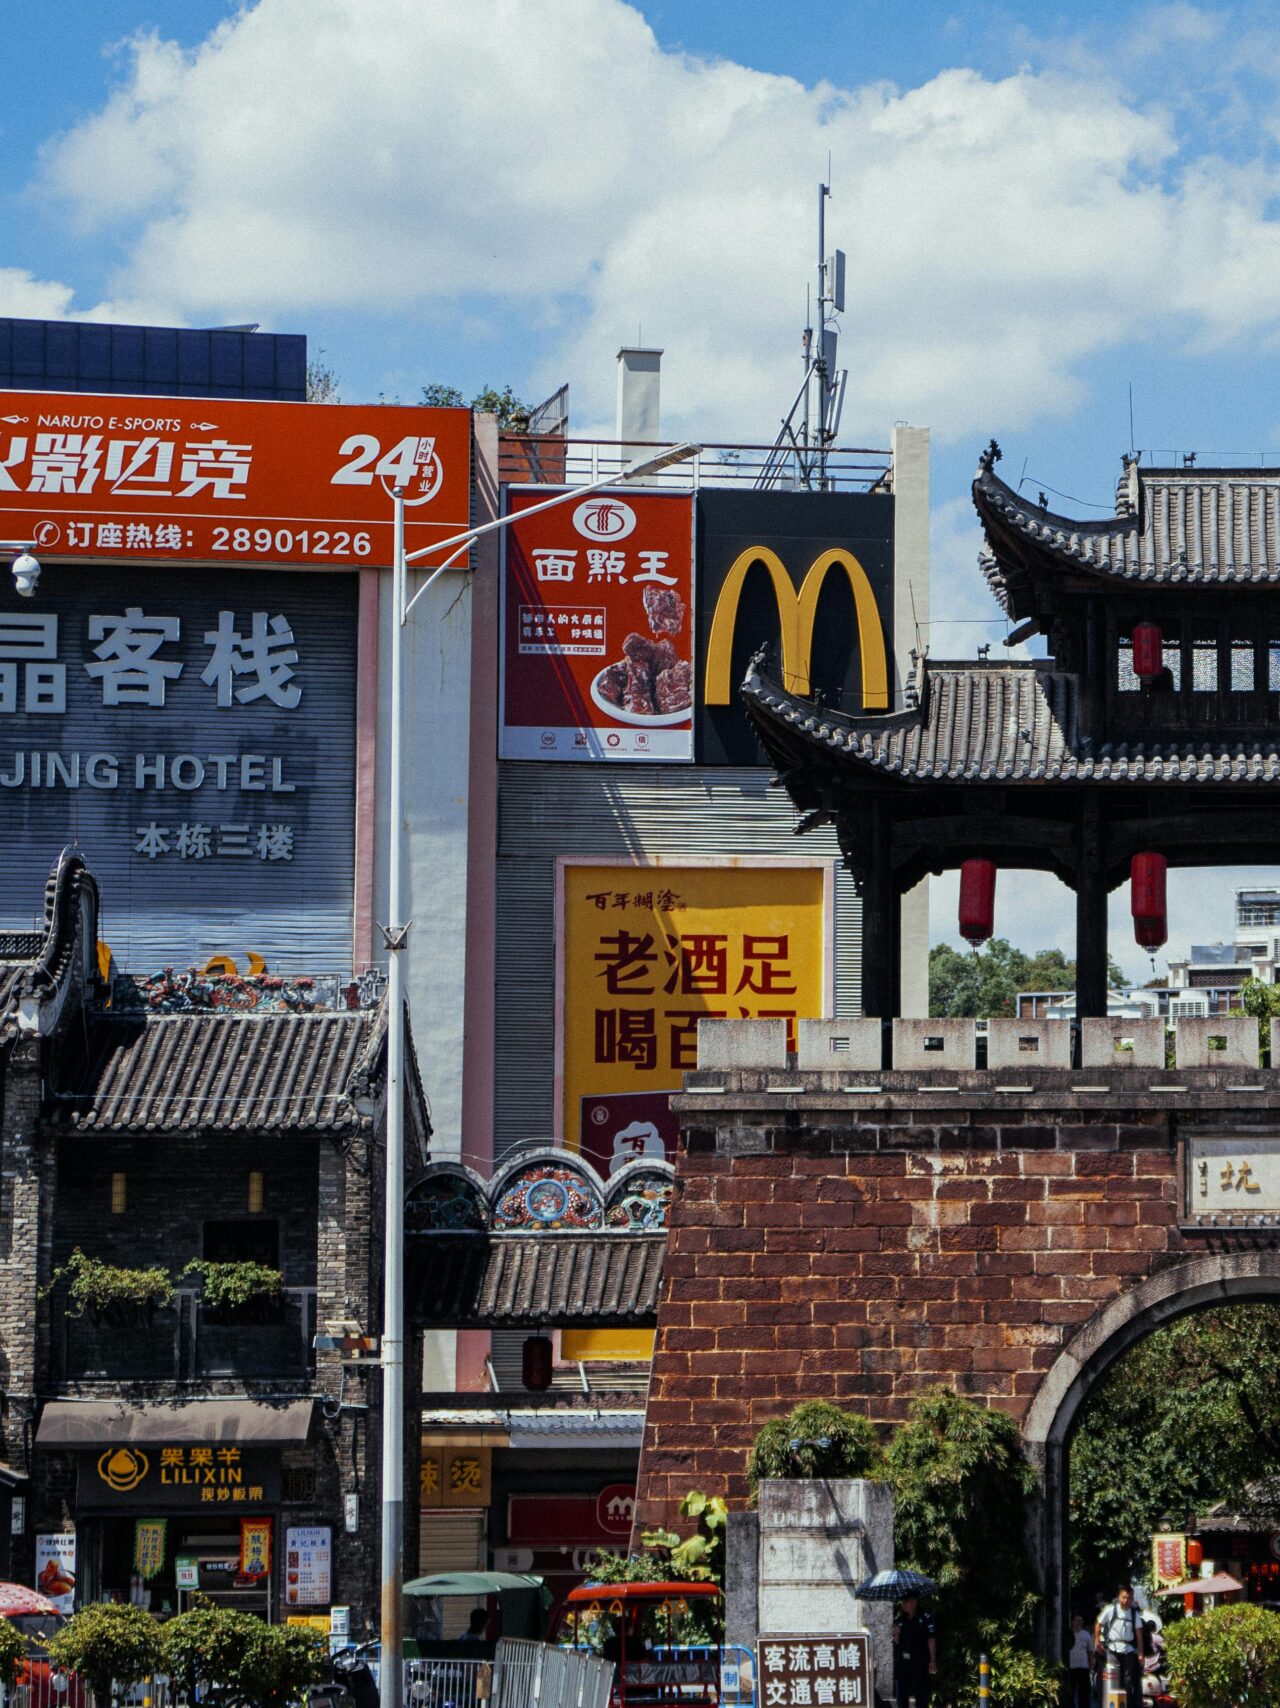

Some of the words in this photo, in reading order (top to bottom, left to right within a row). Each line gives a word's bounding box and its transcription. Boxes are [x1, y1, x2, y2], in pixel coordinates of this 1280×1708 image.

[36, 414, 104, 430] NARUTO
[108, 416, 182, 432] E-SPORTS
[331, 434, 420, 486] 24
[212, 527, 371, 556] 28901226
[0, 752, 119, 789] JING
[135, 753, 296, 792] HOTEL
[134, 822, 295, 861] 本栋三楼
[594, 930, 798, 996] 老酒足
[161, 1467, 243, 1485] LILIXIN
[764, 1644, 861, 1673] 客流高峰
[724, 1671, 738, 1687] 制
[766, 1676, 861, 1706] 交通管制
